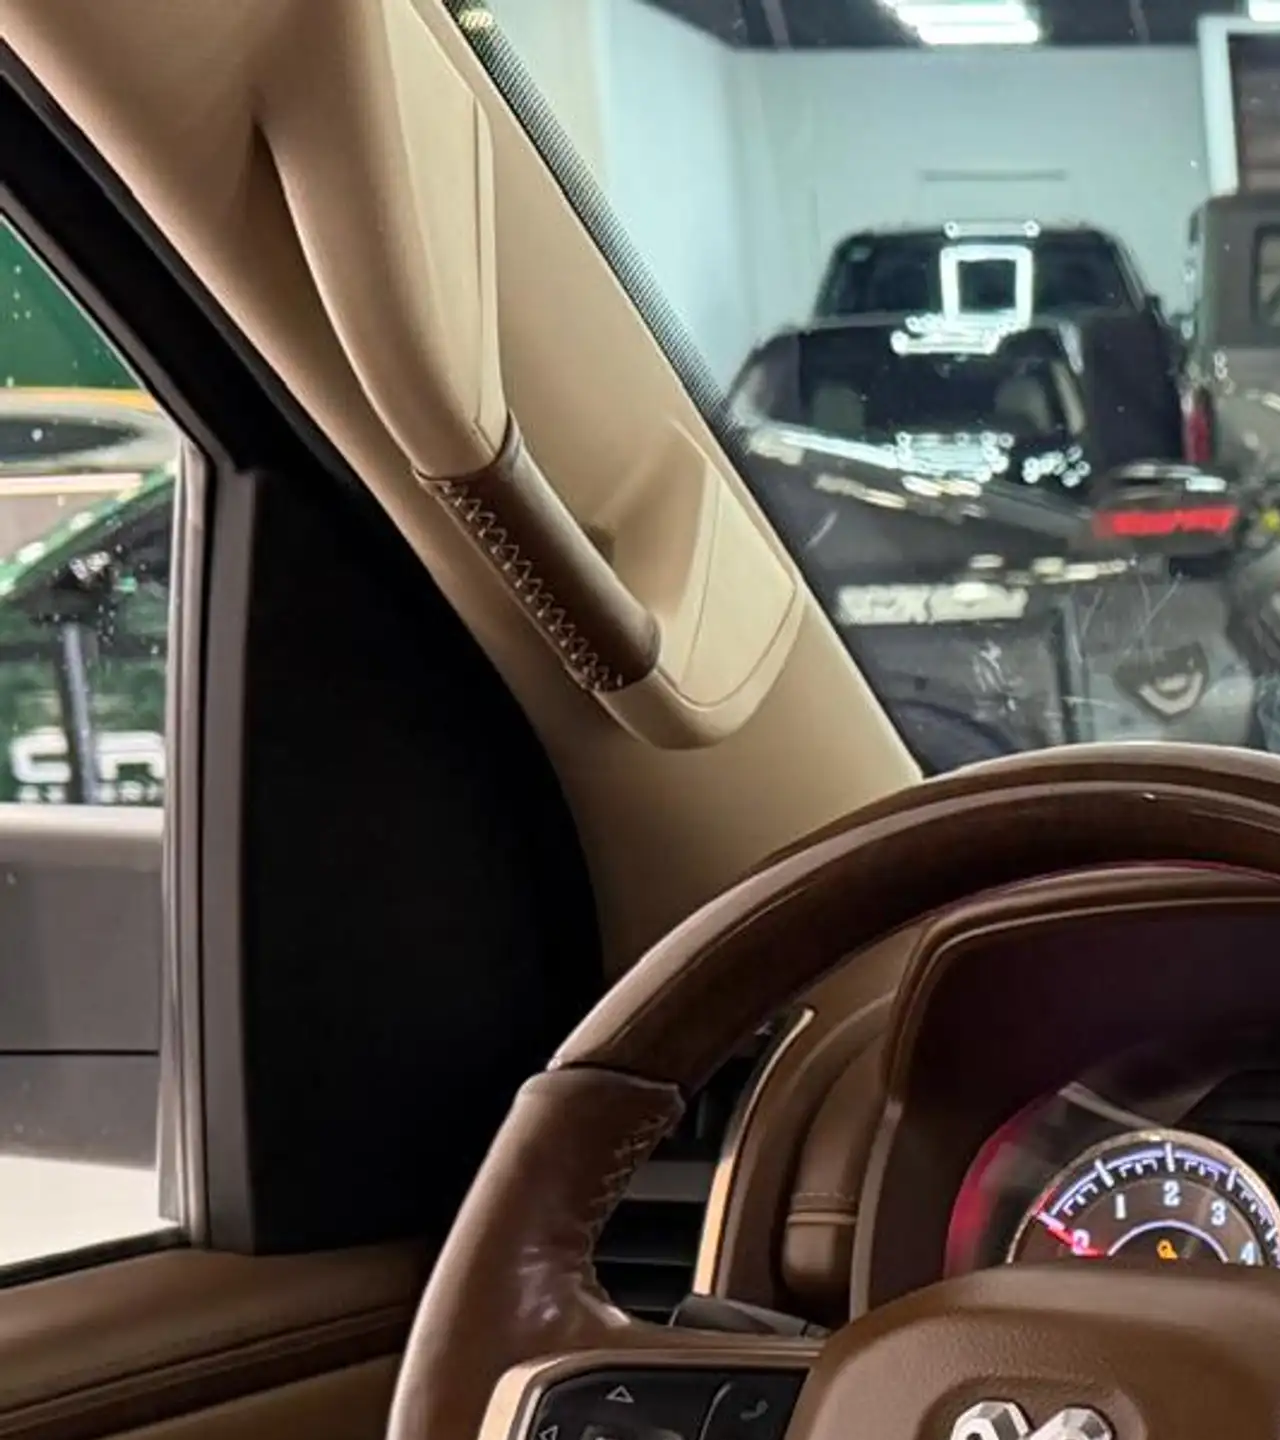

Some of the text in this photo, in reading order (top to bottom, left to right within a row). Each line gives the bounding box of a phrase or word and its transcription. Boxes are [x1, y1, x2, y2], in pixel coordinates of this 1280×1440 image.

[1116, 1193, 1126, 1219] 1
[1162, 1180, 1181, 1207] 2
[1210, 1200, 1227, 1226] 3
